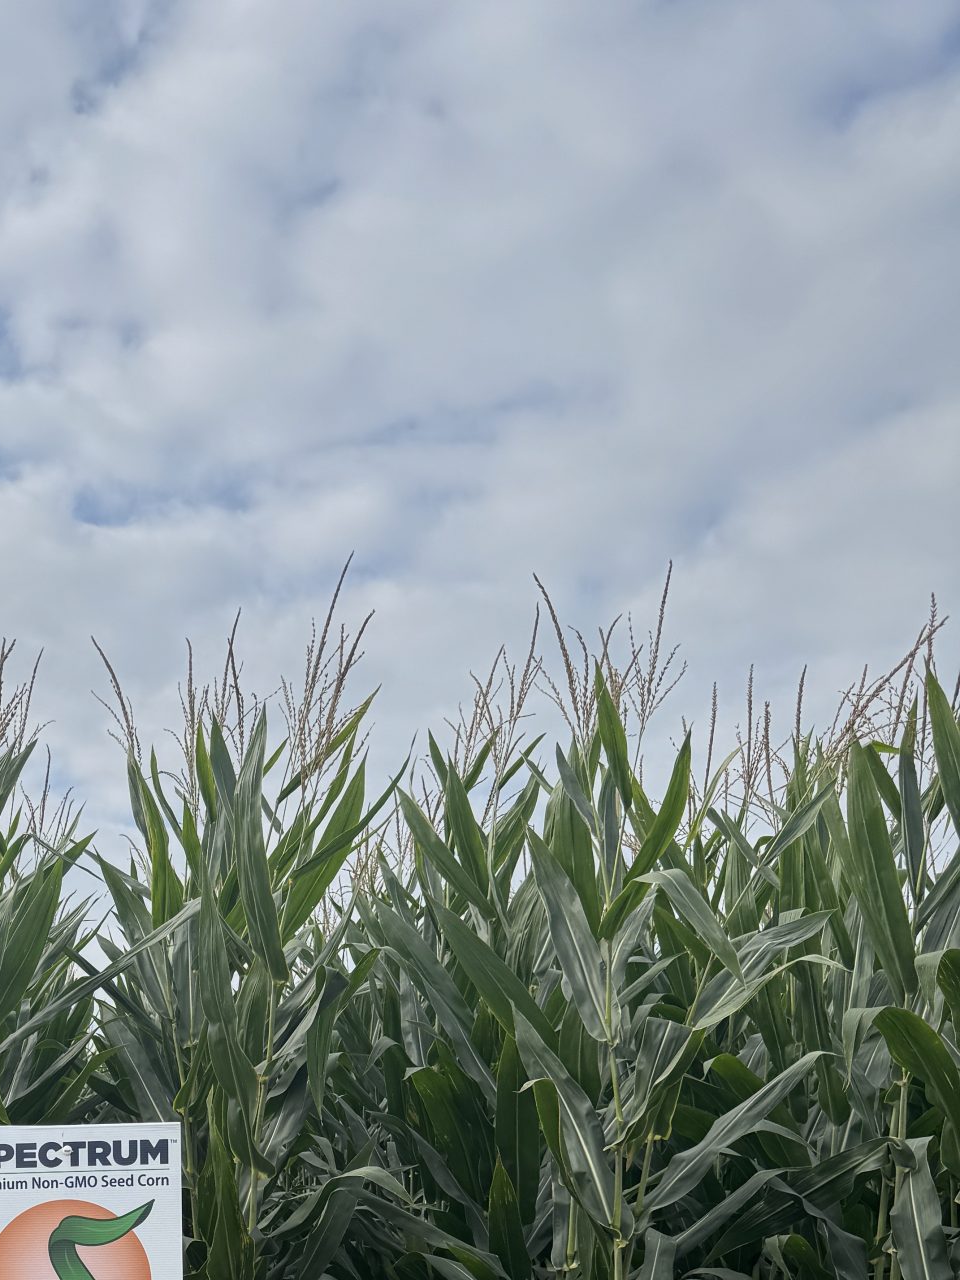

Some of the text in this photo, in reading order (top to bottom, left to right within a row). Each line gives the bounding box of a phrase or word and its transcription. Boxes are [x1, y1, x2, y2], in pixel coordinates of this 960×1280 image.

[31, 1176, 98, 1189] Non-GMO
[101, 1174, 134, 1188] Seed
[137, 1174, 170, 1187] Corn
